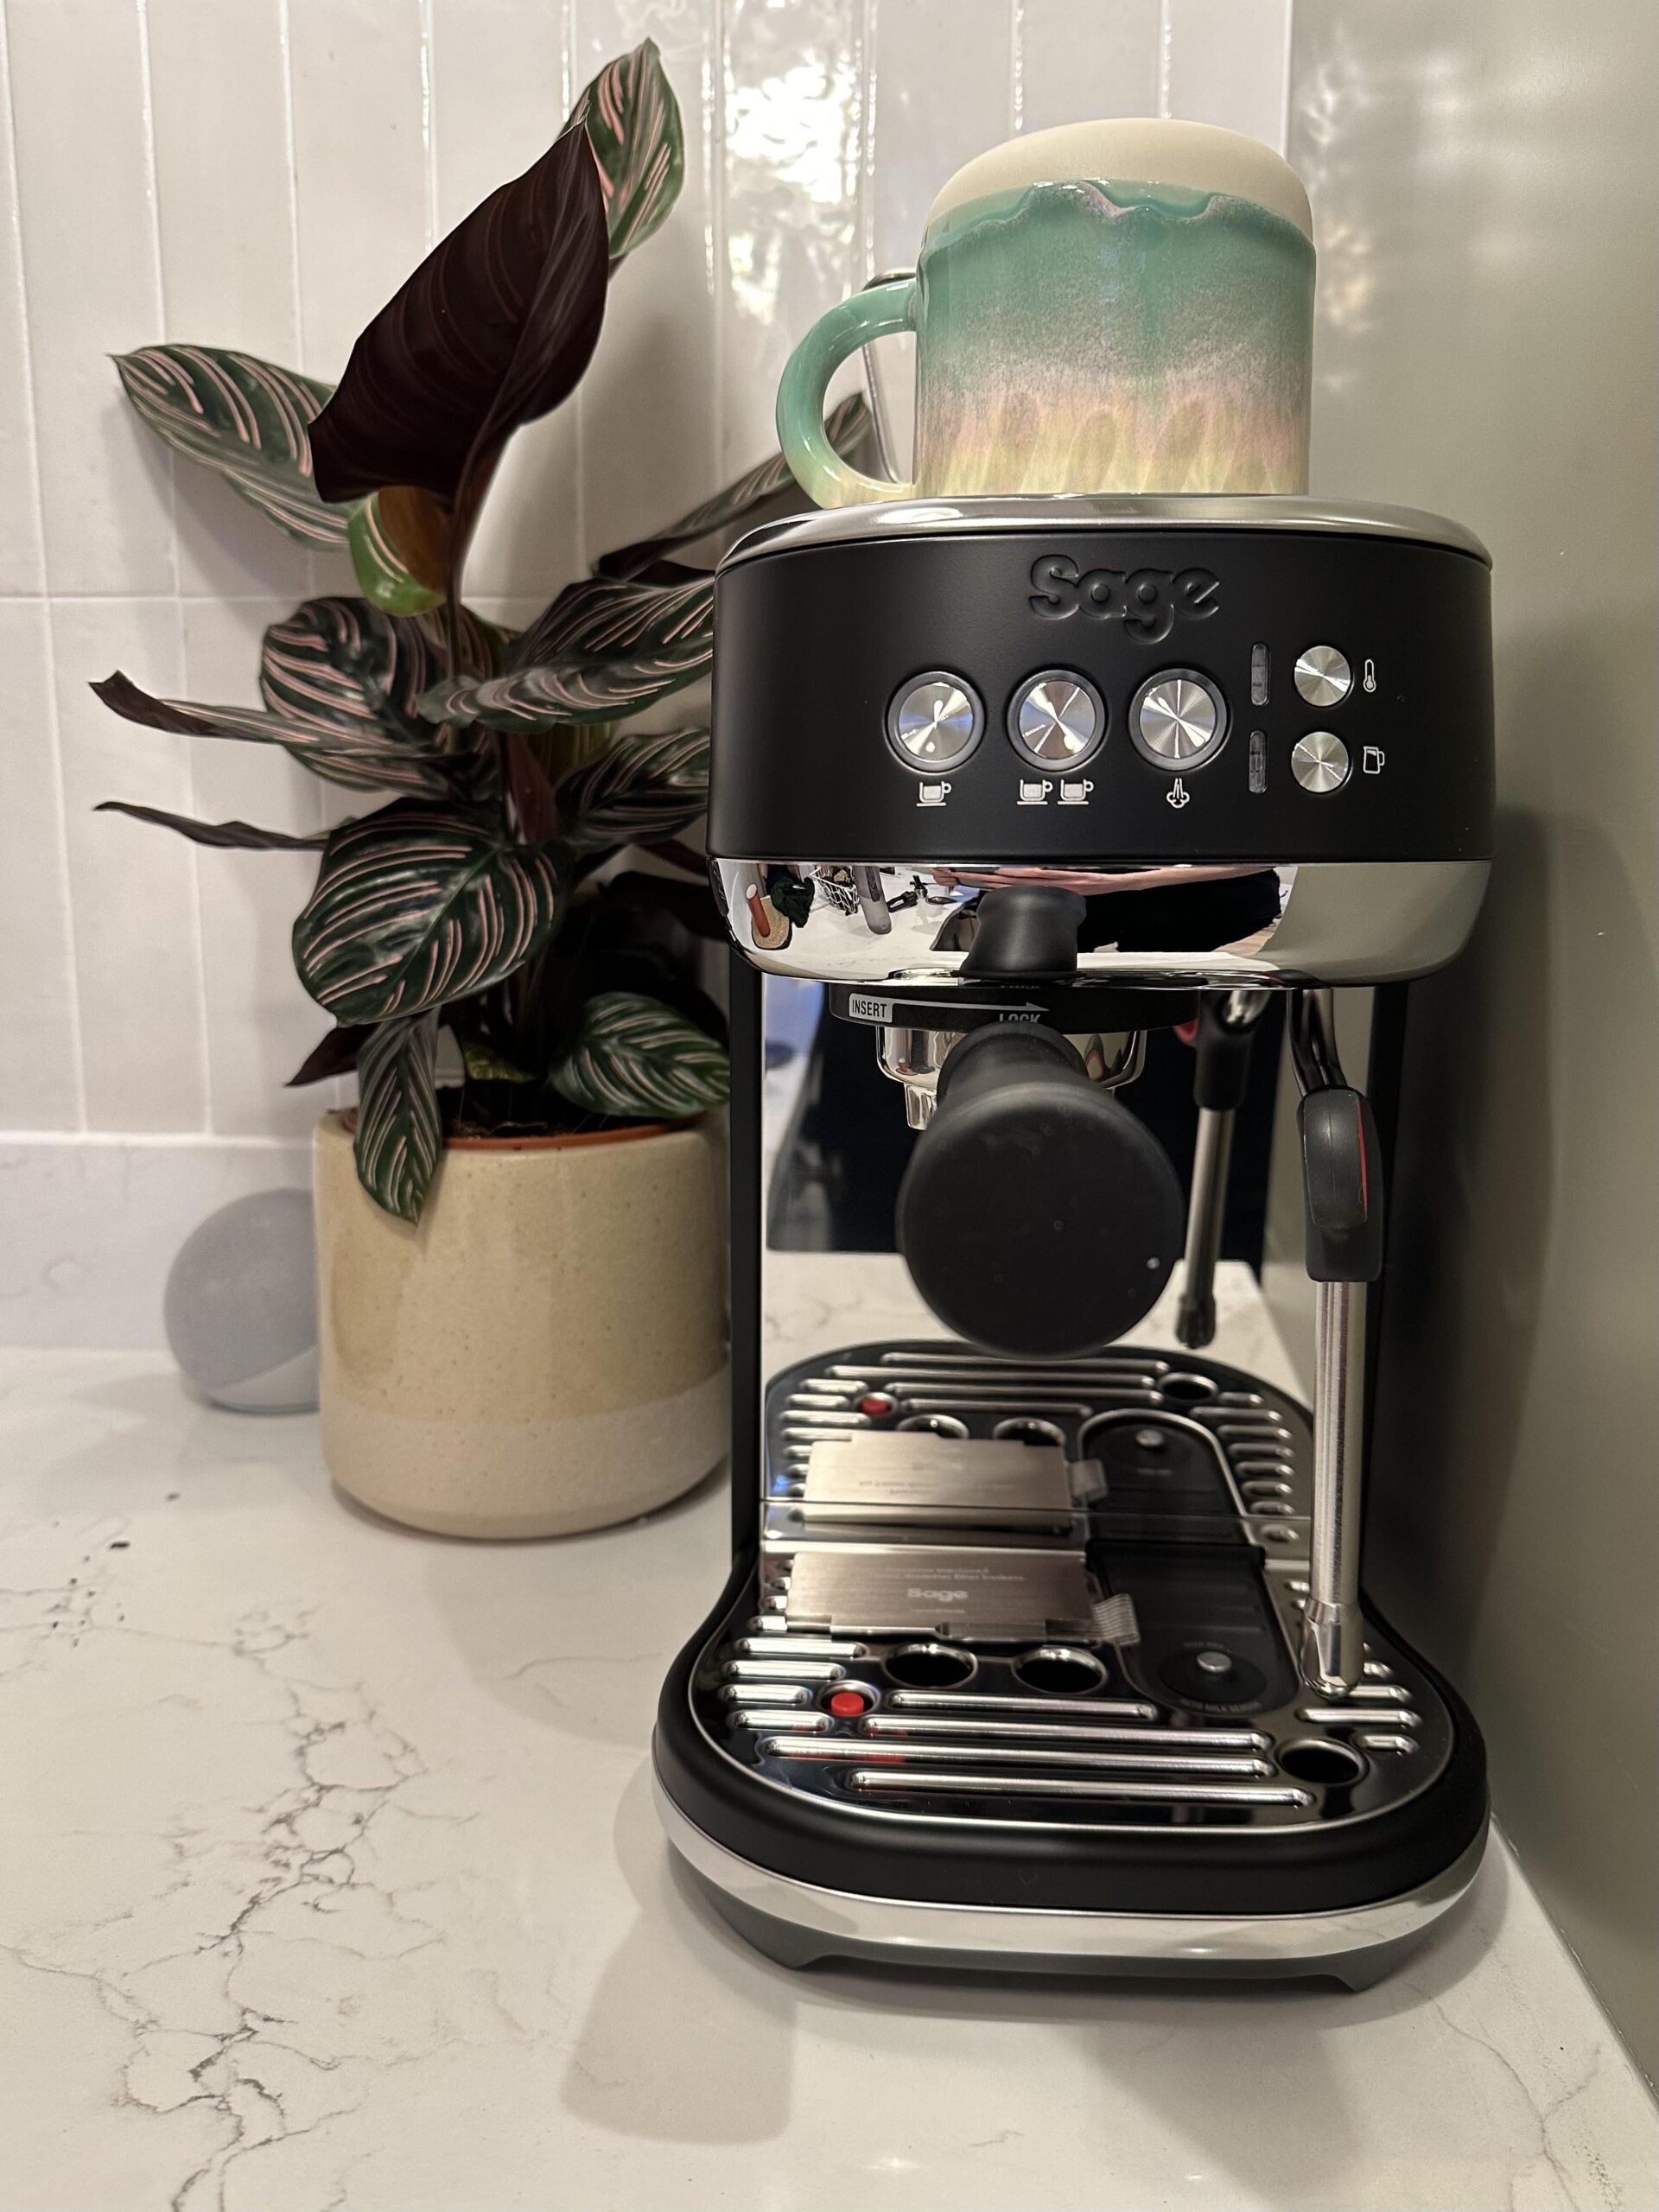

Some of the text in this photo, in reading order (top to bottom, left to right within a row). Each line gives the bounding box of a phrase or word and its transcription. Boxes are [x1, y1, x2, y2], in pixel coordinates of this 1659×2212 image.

[1028, 554, 1220, 645] Sage
[851, 999, 887, 1018] INSERT
[999, 1013, 1041, 1023] LOCK
[907, 1587, 969, 1602] Sage
